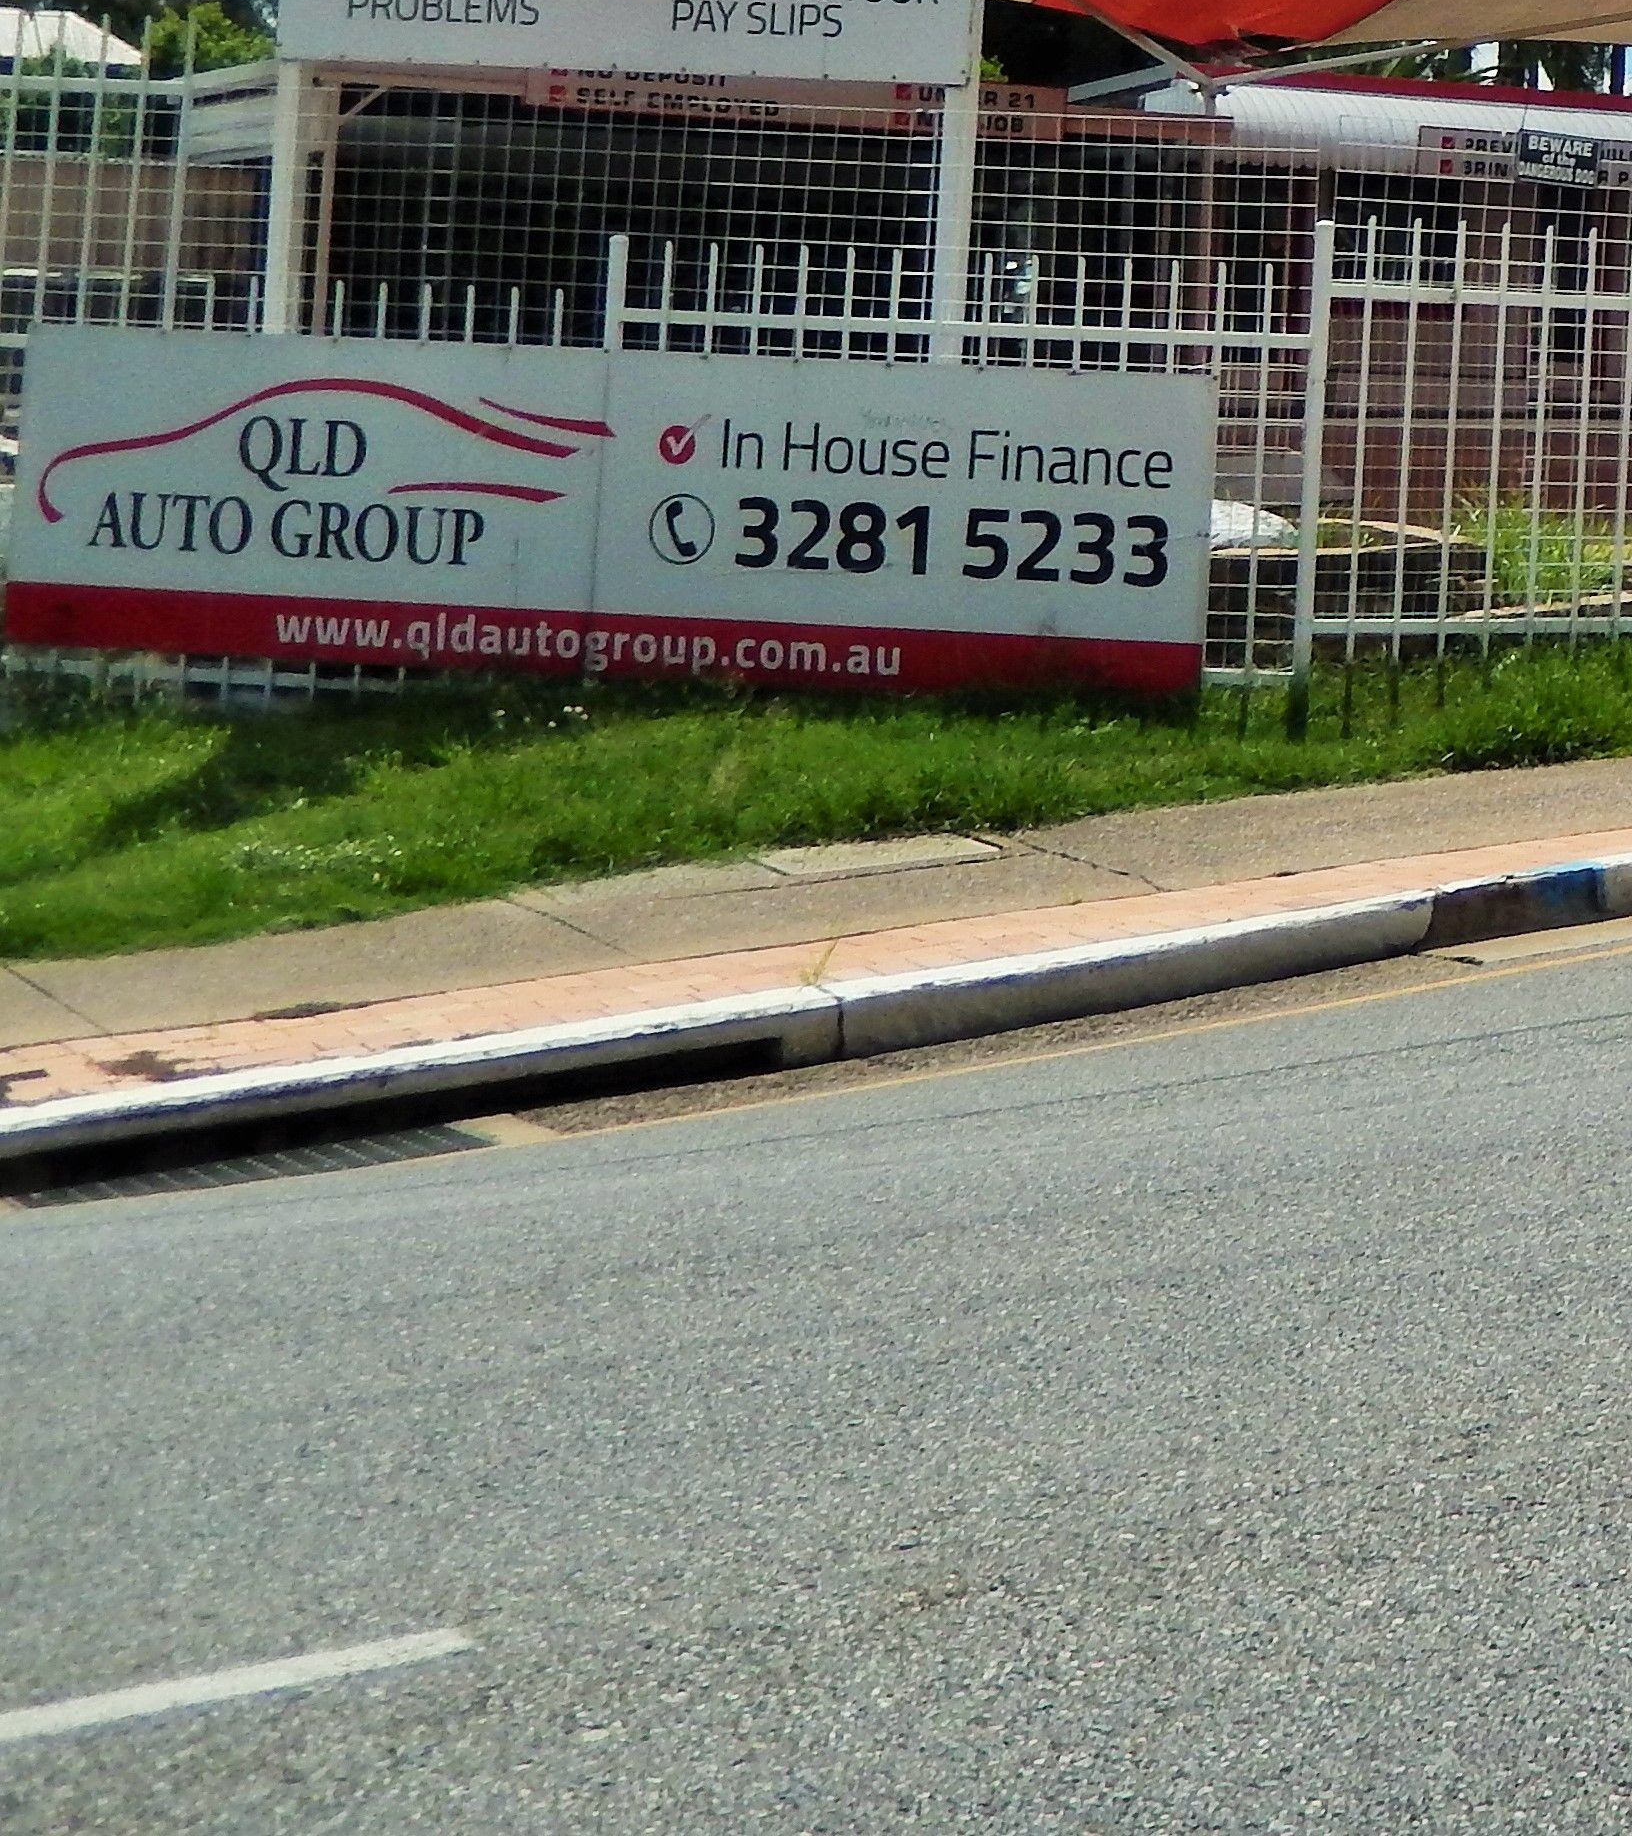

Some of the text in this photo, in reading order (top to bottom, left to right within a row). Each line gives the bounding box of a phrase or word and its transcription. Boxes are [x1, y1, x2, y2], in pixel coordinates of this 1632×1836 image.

[671, 0, 844, 39] PAY SLIPS
[918, 85, 1036, 109] UNR 21
[1528, 134, 1594, 157] BEWARE
[236, 413, 368, 485] QLD
[720, 417, 1174, 491] In House Finance
[87, 493, 486, 570] AUTO GROUP
[733, 495, 1172, 589] 3281 5233
[275, 607, 904, 678] www.qldautogroup.com.au
